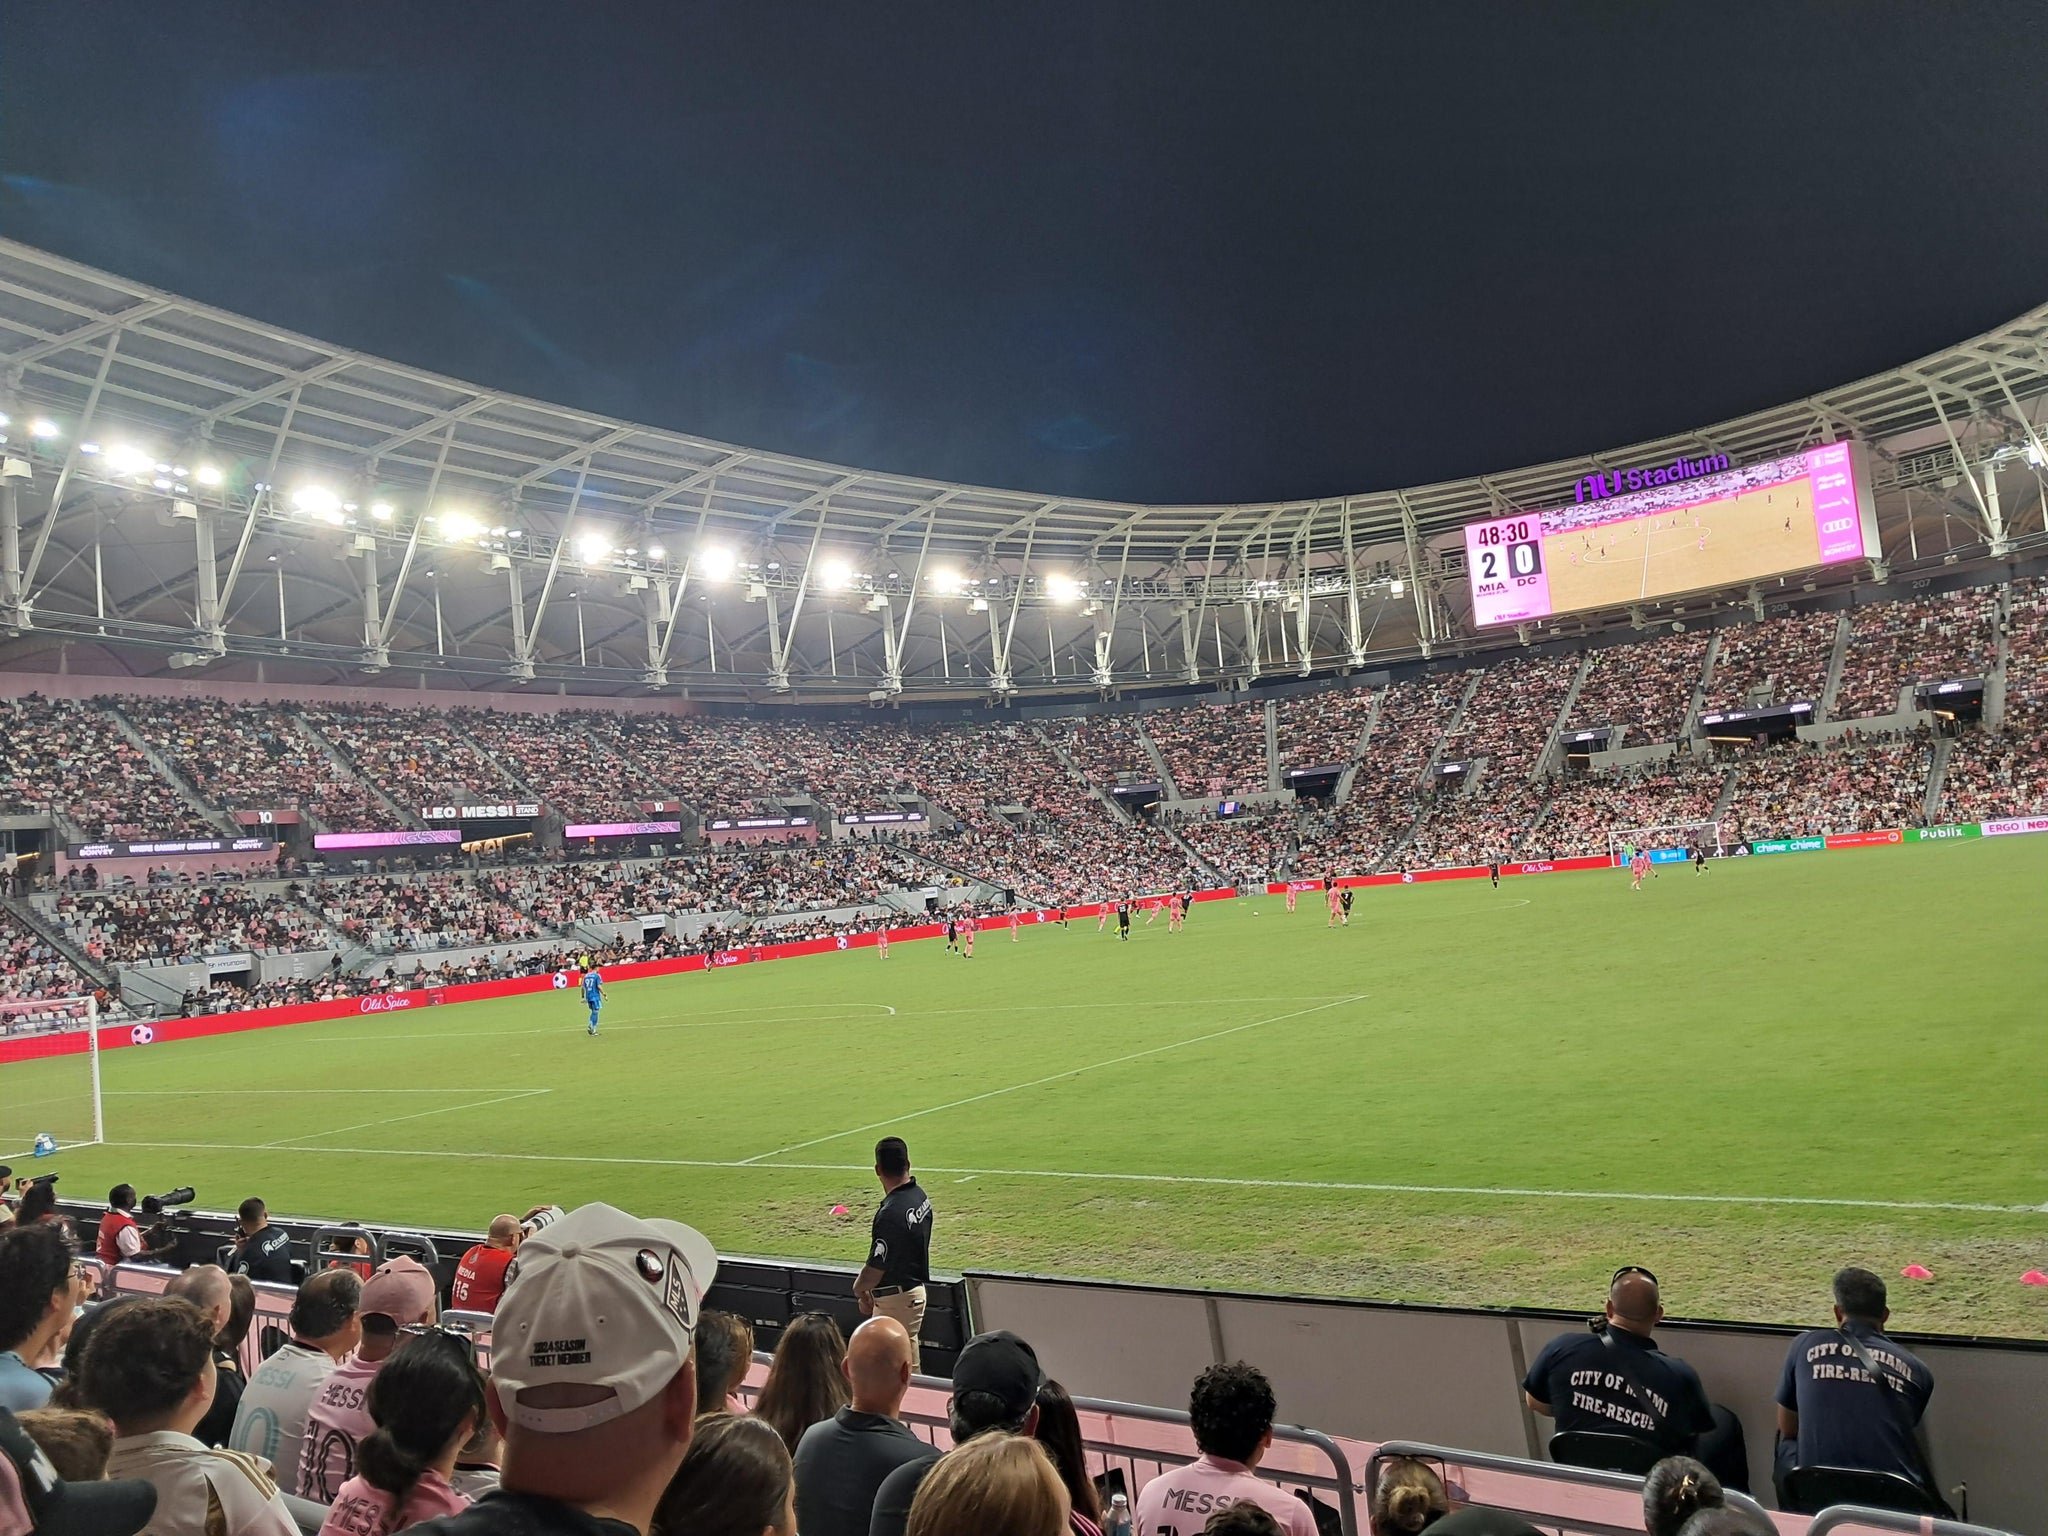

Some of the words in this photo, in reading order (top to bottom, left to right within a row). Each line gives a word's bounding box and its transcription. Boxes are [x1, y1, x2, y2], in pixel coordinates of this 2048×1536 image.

[1626, 453, 1729, 491] Stadium
[1478, 521, 1529, 547] 48:30
[1481, 551, 1498, 579] 2
[1514, 544, 1534, 574] 0
[1478, 582, 1506, 593] MIA
[1517, 576, 1537, 587] DC
[1912, 578, 1931, 589] 207
[1771, 602, 1789, 613] 208
[1528, 644, 1542, 654] 210
[422, 806, 457, 819] LEO
[461, 805, 513, 818] MESSI
[654, 802, 664, 813] 10
[258, 811, 273, 824] 10
[1920, 828, 1964, 840] Publix
[1988, 822, 2020, 834] ERGO
[1756, 842, 1787, 853] chime
[1789, 839, 1822, 850] chime
[1535, 863, 1554, 873] Spice
[584, 978, 594, 988] 97
[360, 998, 383, 1013] Old
[382, 995, 410, 1012] Spice
[670, 1278, 682, 1311] MLS
[554, 1338, 586, 1353] SEASON
[1806, 1342, 1839, 1363] CITY
[529, 1354, 556, 1367] TICKET
[557, 1351, 592, 1366] MEMBER
[1570, 1370, 1602, 1386] CITY
[1604, 1373, 1624, 1391] OF
[1812, 1363, 1905, 1393] FIRE-REUE
[1572, 1391, 1656, 1431] FIRE-RESCUE
[1162, 1487, 1241, 1515] MESS
